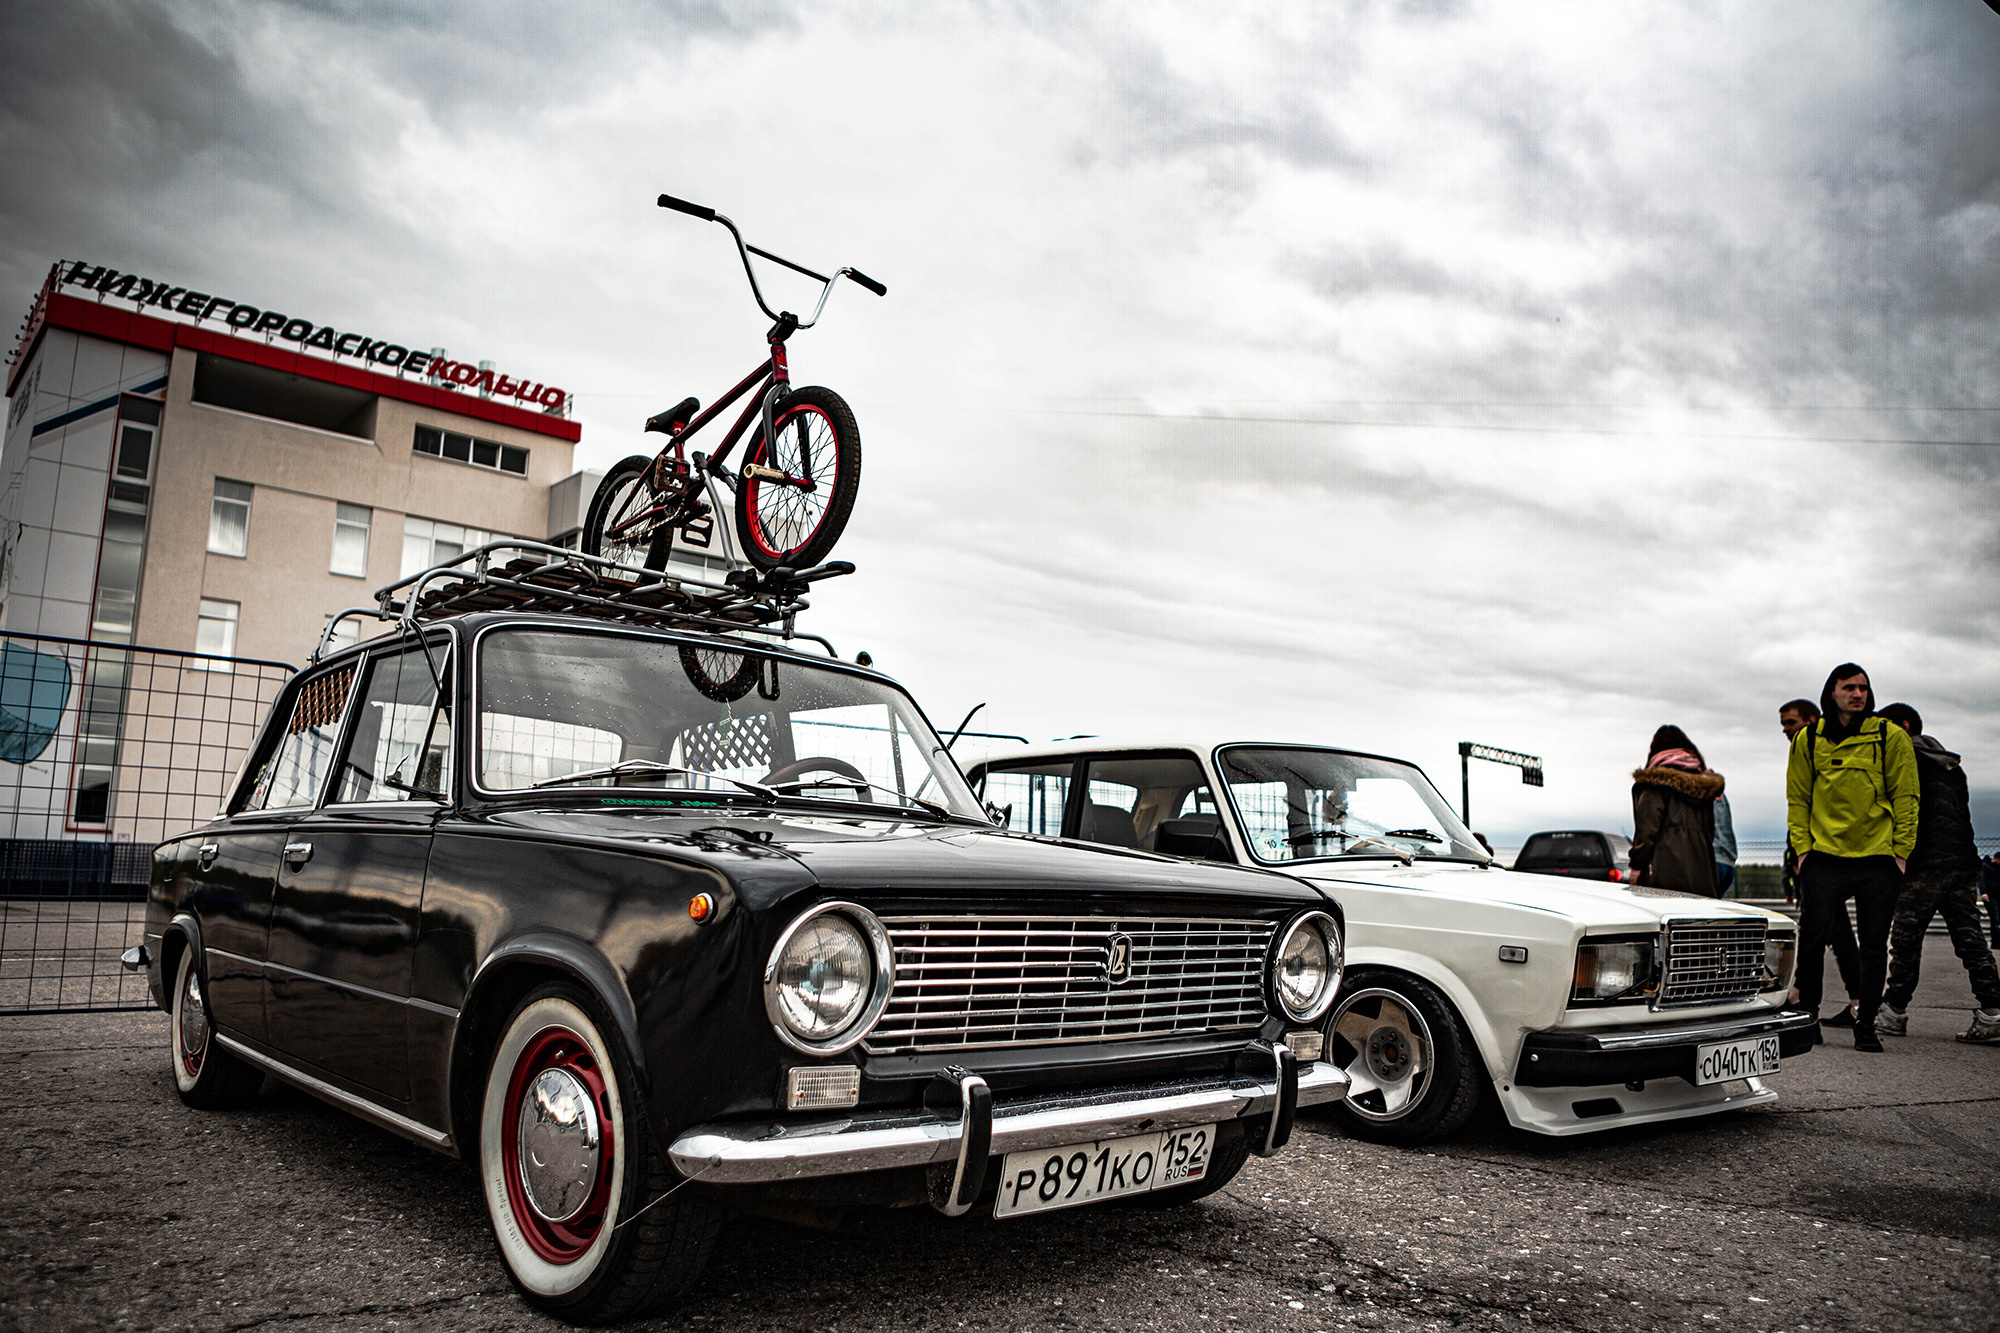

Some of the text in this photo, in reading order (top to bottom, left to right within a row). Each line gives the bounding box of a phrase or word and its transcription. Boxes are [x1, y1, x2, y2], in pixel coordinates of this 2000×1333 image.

[62, 260, 567, 408] НИЖЕГОРОДСКОЕ КОЛЬЦО
[1758, 1038, 1778, 1062] 152
[1162, 1130, 1207, 1169] 152
[1164, 1165, 1188, 1181] RUS
